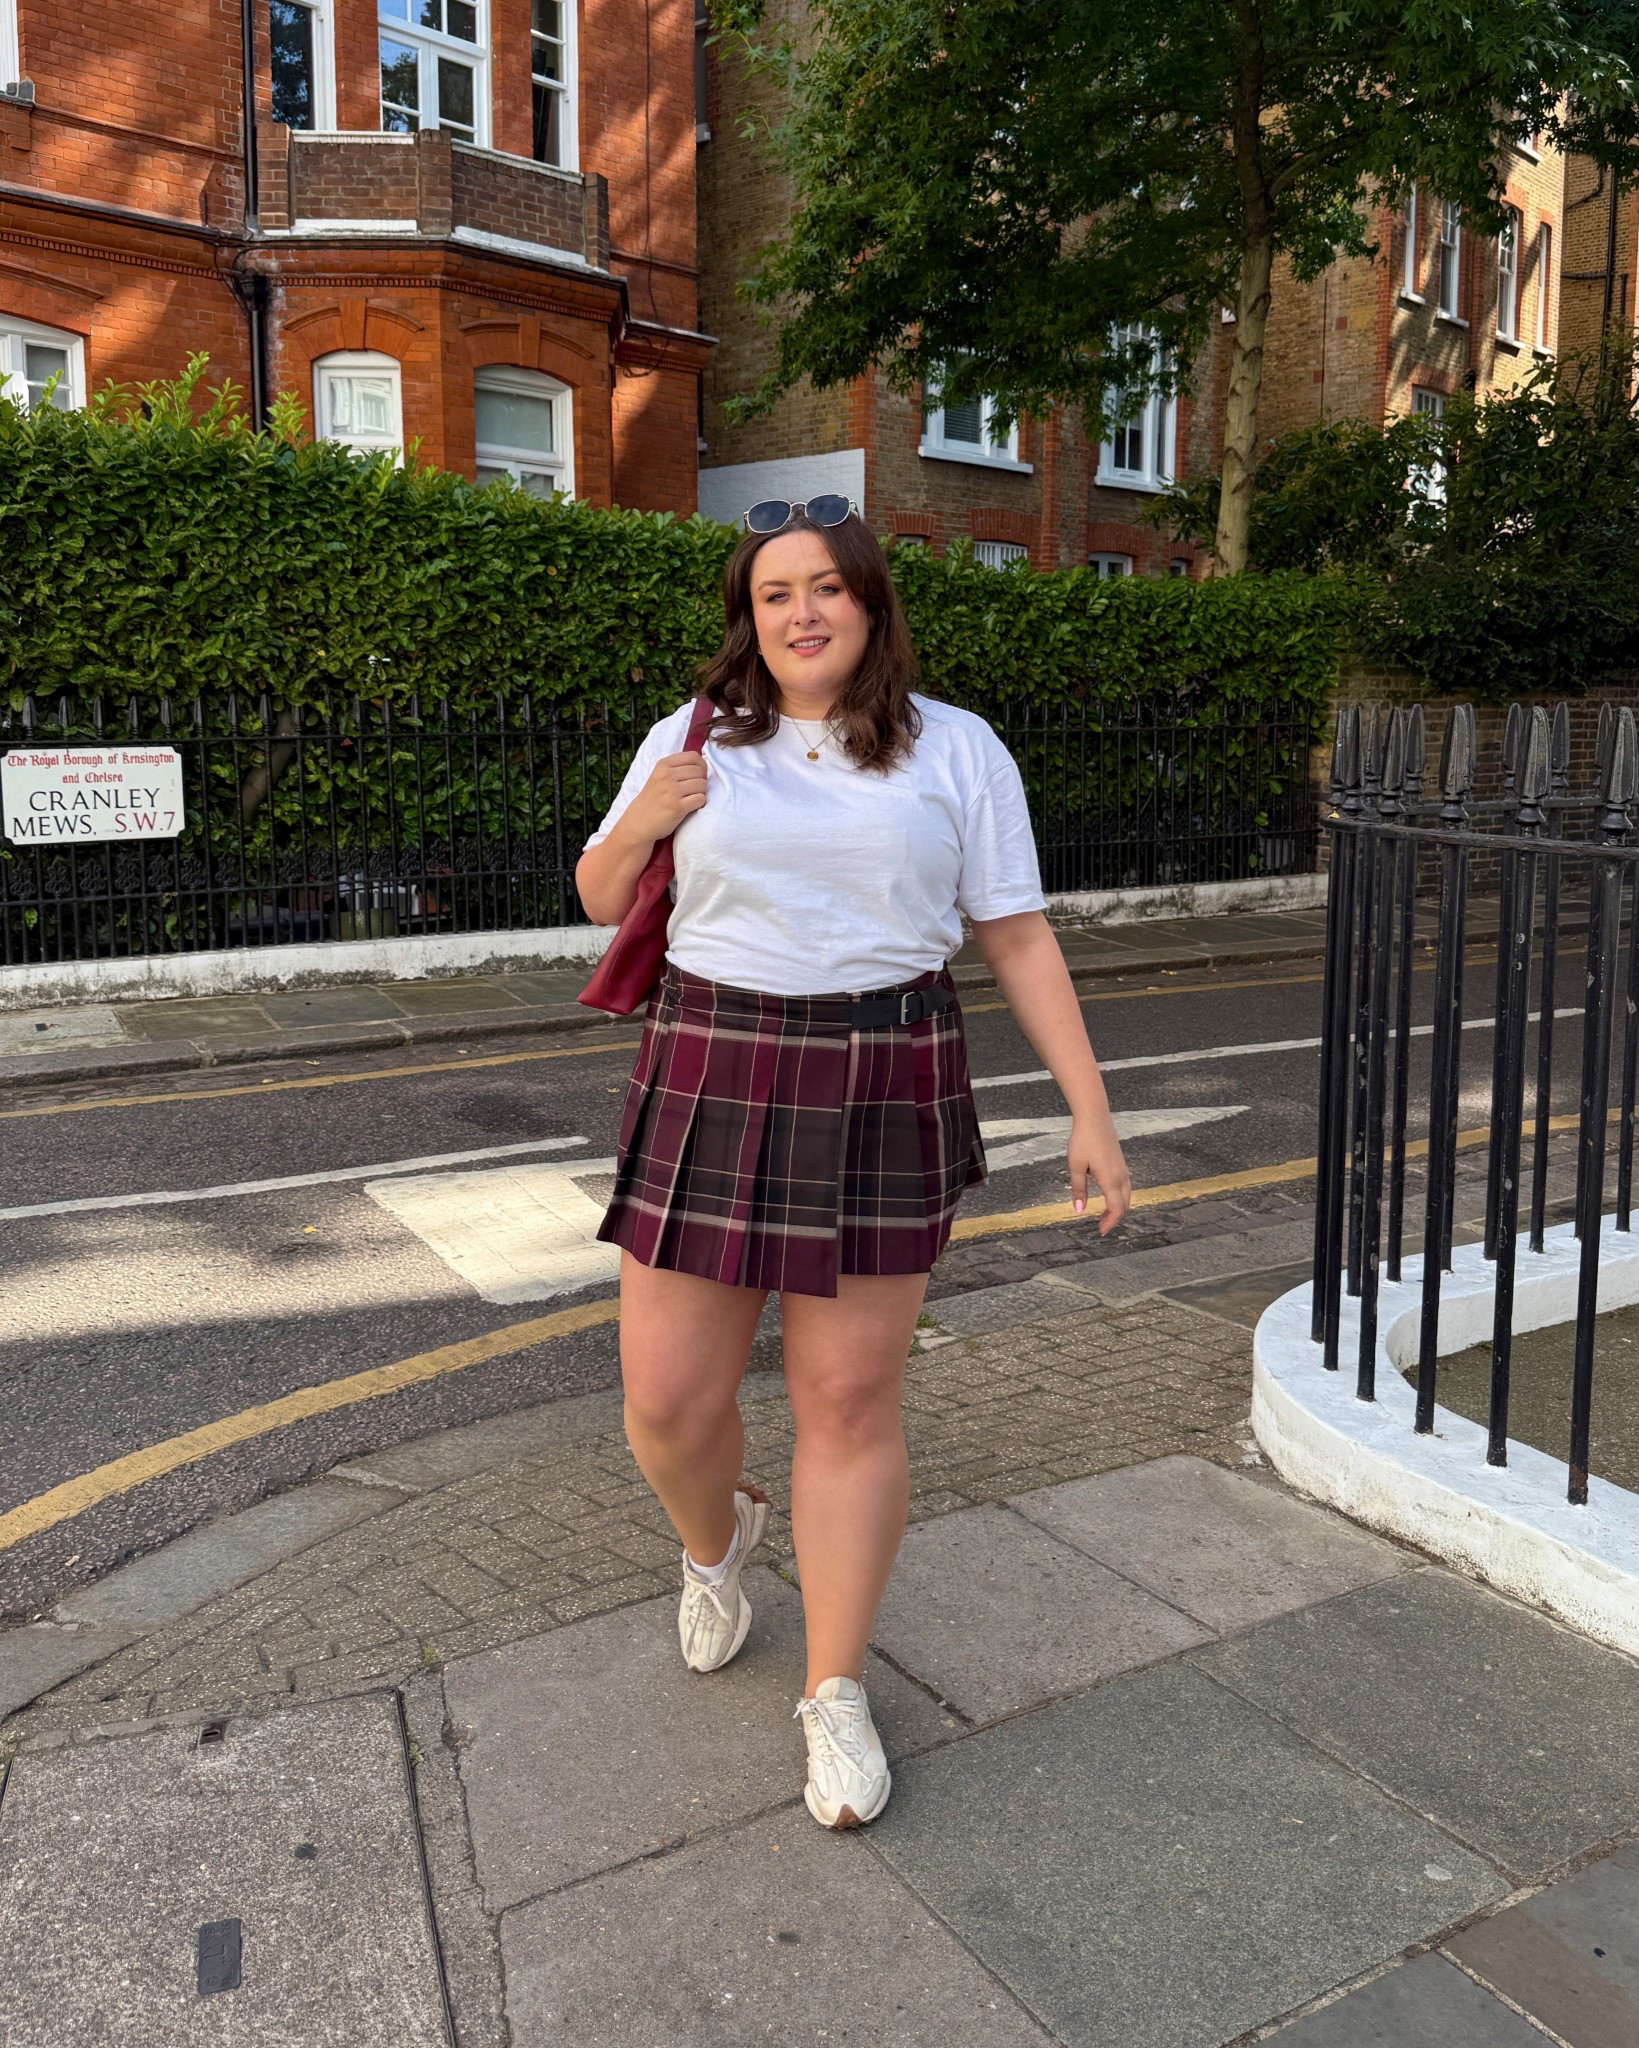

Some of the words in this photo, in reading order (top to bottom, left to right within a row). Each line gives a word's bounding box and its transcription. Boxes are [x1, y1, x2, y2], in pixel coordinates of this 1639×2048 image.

[8, 756, 27, 767] The
[30, 755, 59, 769] Royal
[64, 754, 103, 768] Borough
[108, 754, 118, 764] of
[122, 752, 174, 766] Kensington
[62, 773, 80, 783] and
[85, 772, 123, 783] Chelsea
[29, 788, 161, 812] CRANLEY
[115, 812, 175, 833] S.W.7
